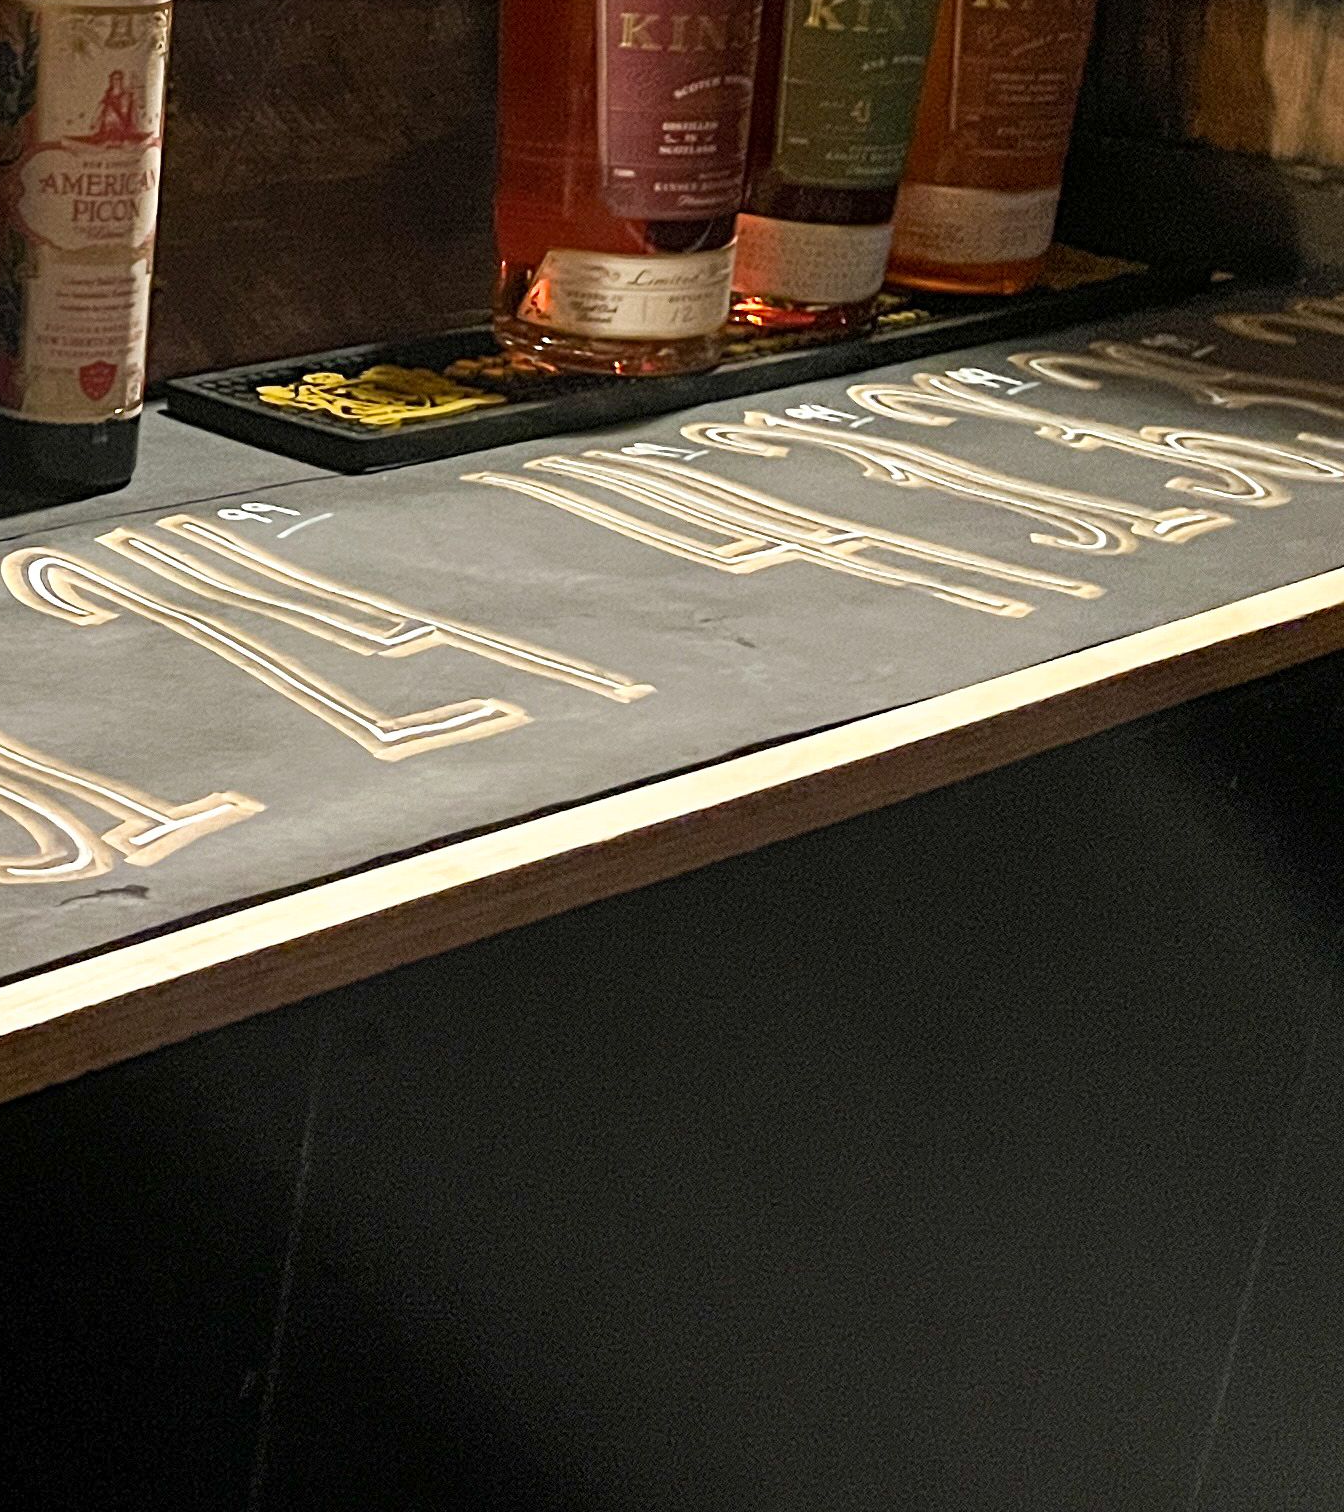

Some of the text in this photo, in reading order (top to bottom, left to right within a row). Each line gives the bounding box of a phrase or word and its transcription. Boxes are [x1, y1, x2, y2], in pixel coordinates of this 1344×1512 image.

[0, 500, 658, 761] 24 99
[459, 449, 1109, 619] 44
